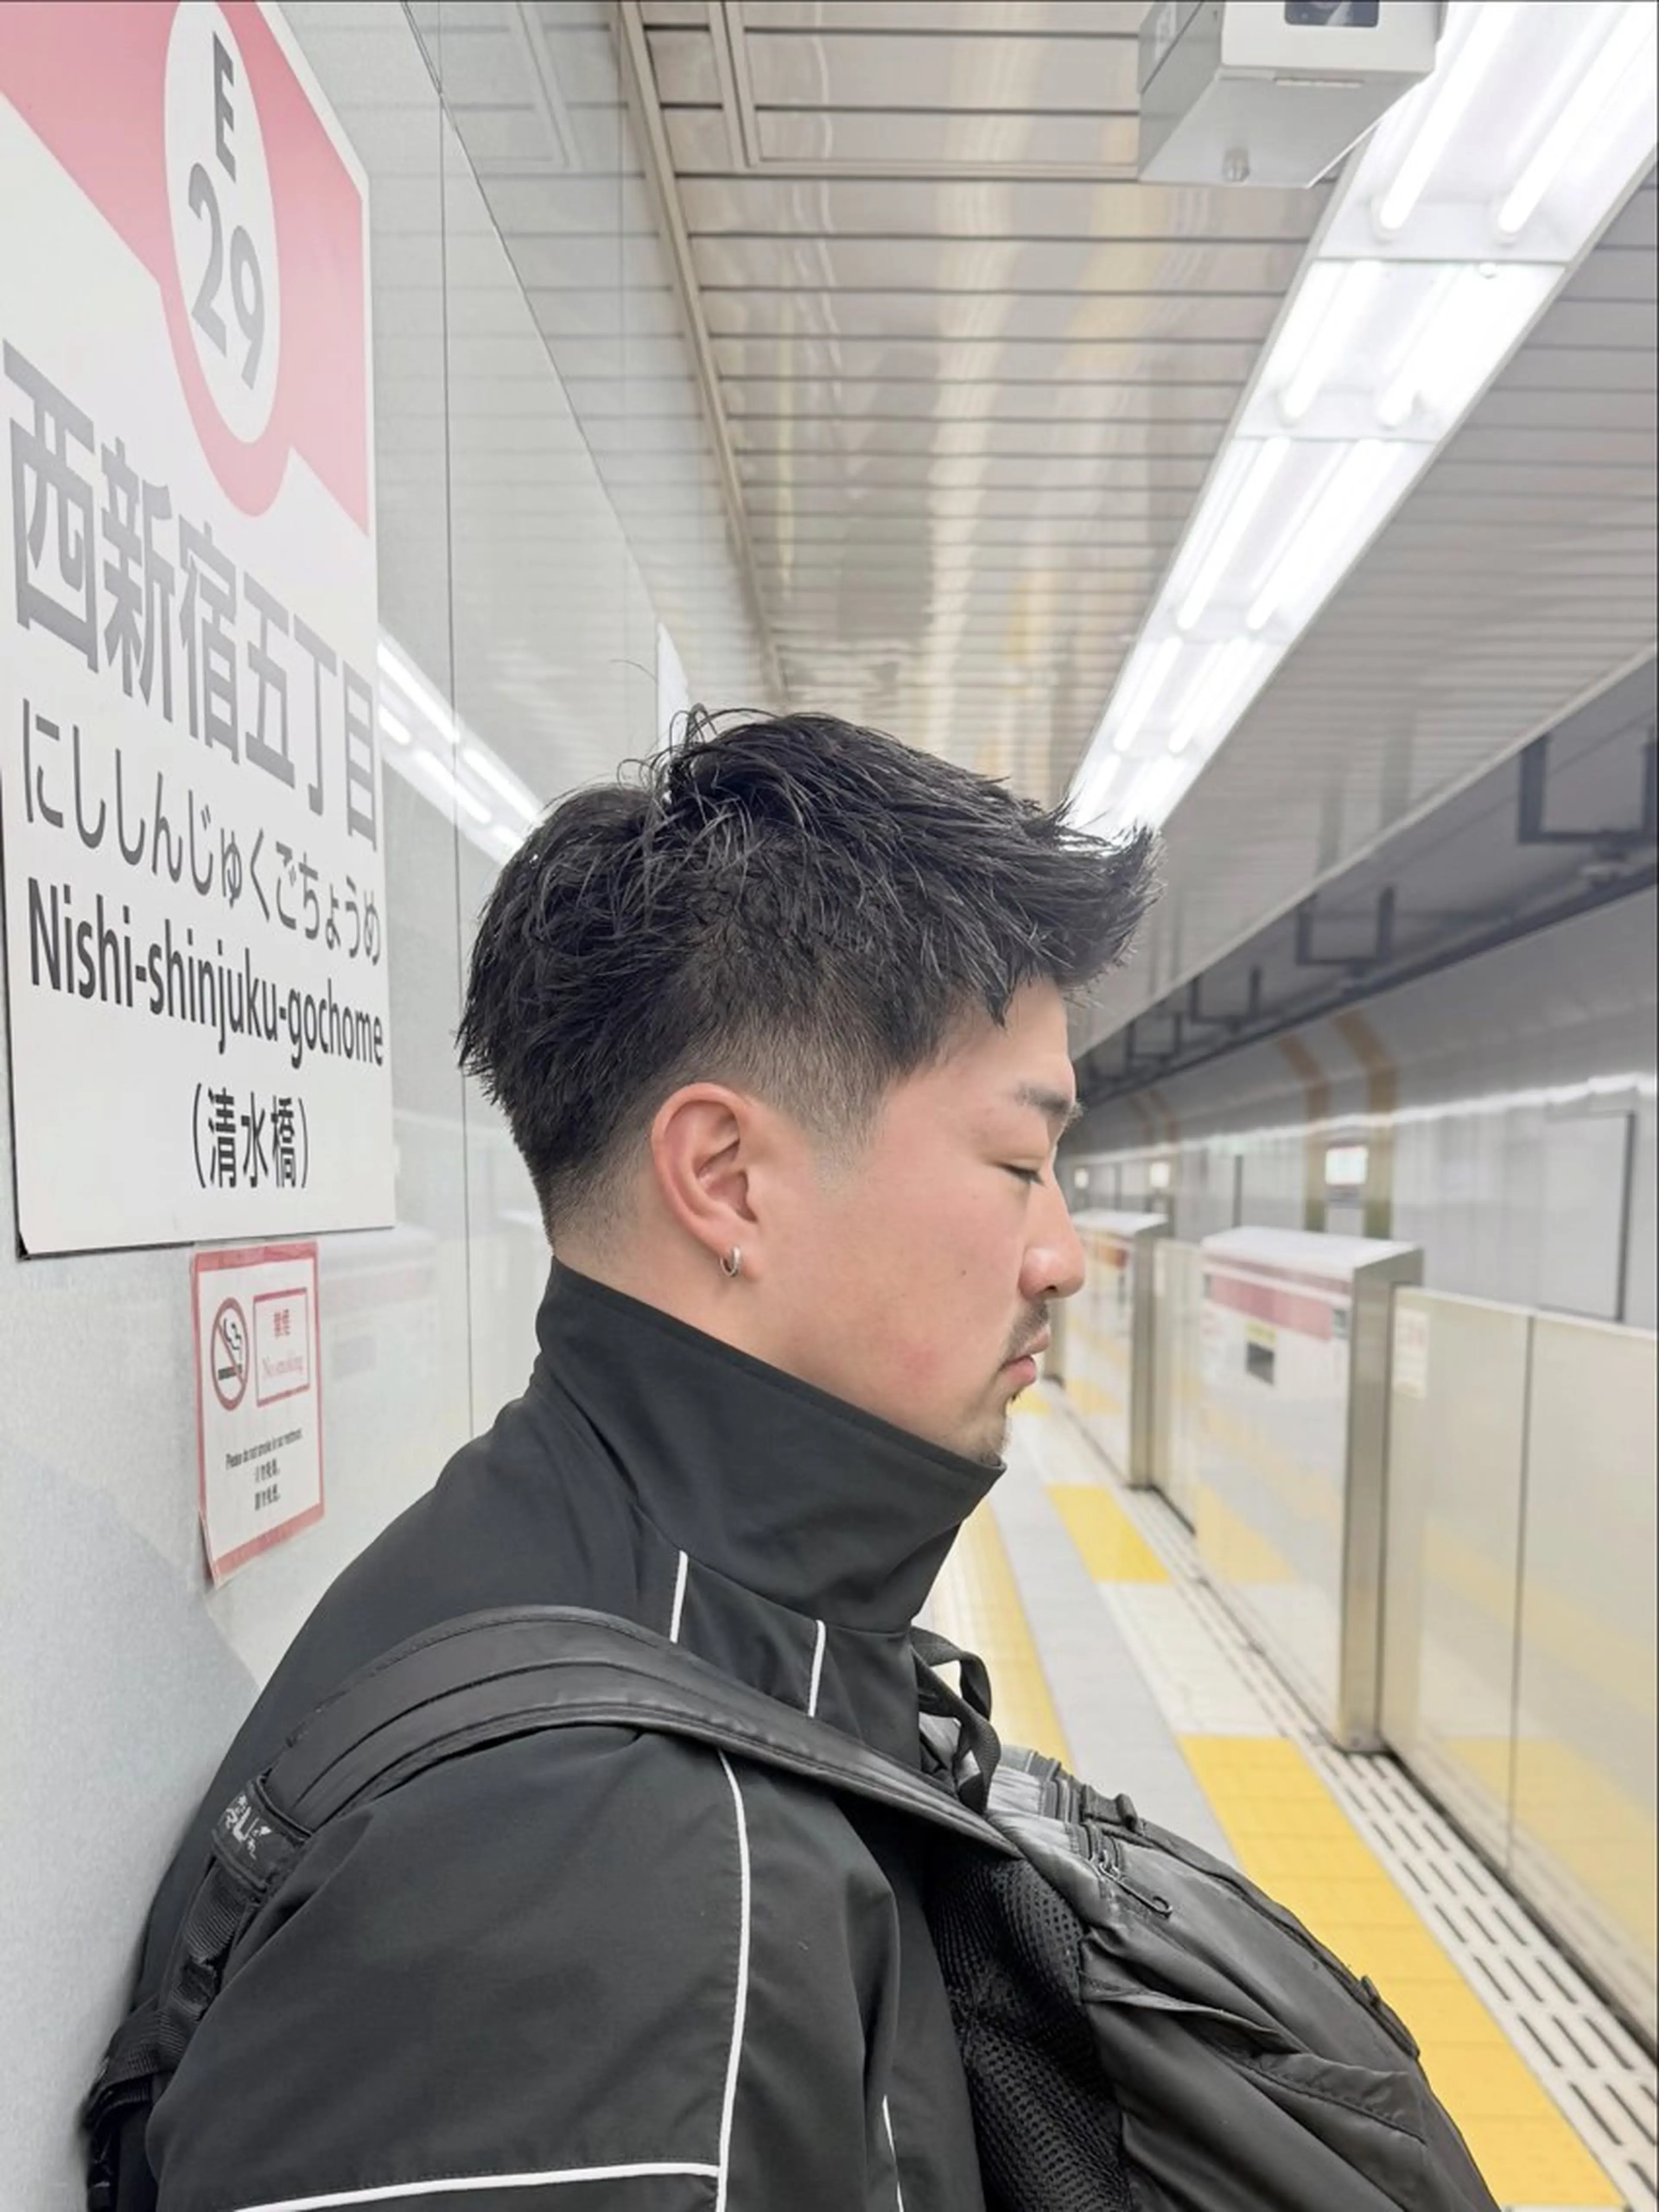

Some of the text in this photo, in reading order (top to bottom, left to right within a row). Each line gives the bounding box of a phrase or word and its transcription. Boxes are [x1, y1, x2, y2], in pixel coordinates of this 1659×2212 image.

[213, 31, 236, 184] E
[188, 163, 264, 389] 29
[3, 339, 377, 852] 西新宿五丁目
[23, 698, 380, 966] にししんじゅくごちょうめ
[28, 877, 384, 1070] Nishi-shinjuku-gochome
[192, 1082, 308, 1189] (清水橋)
